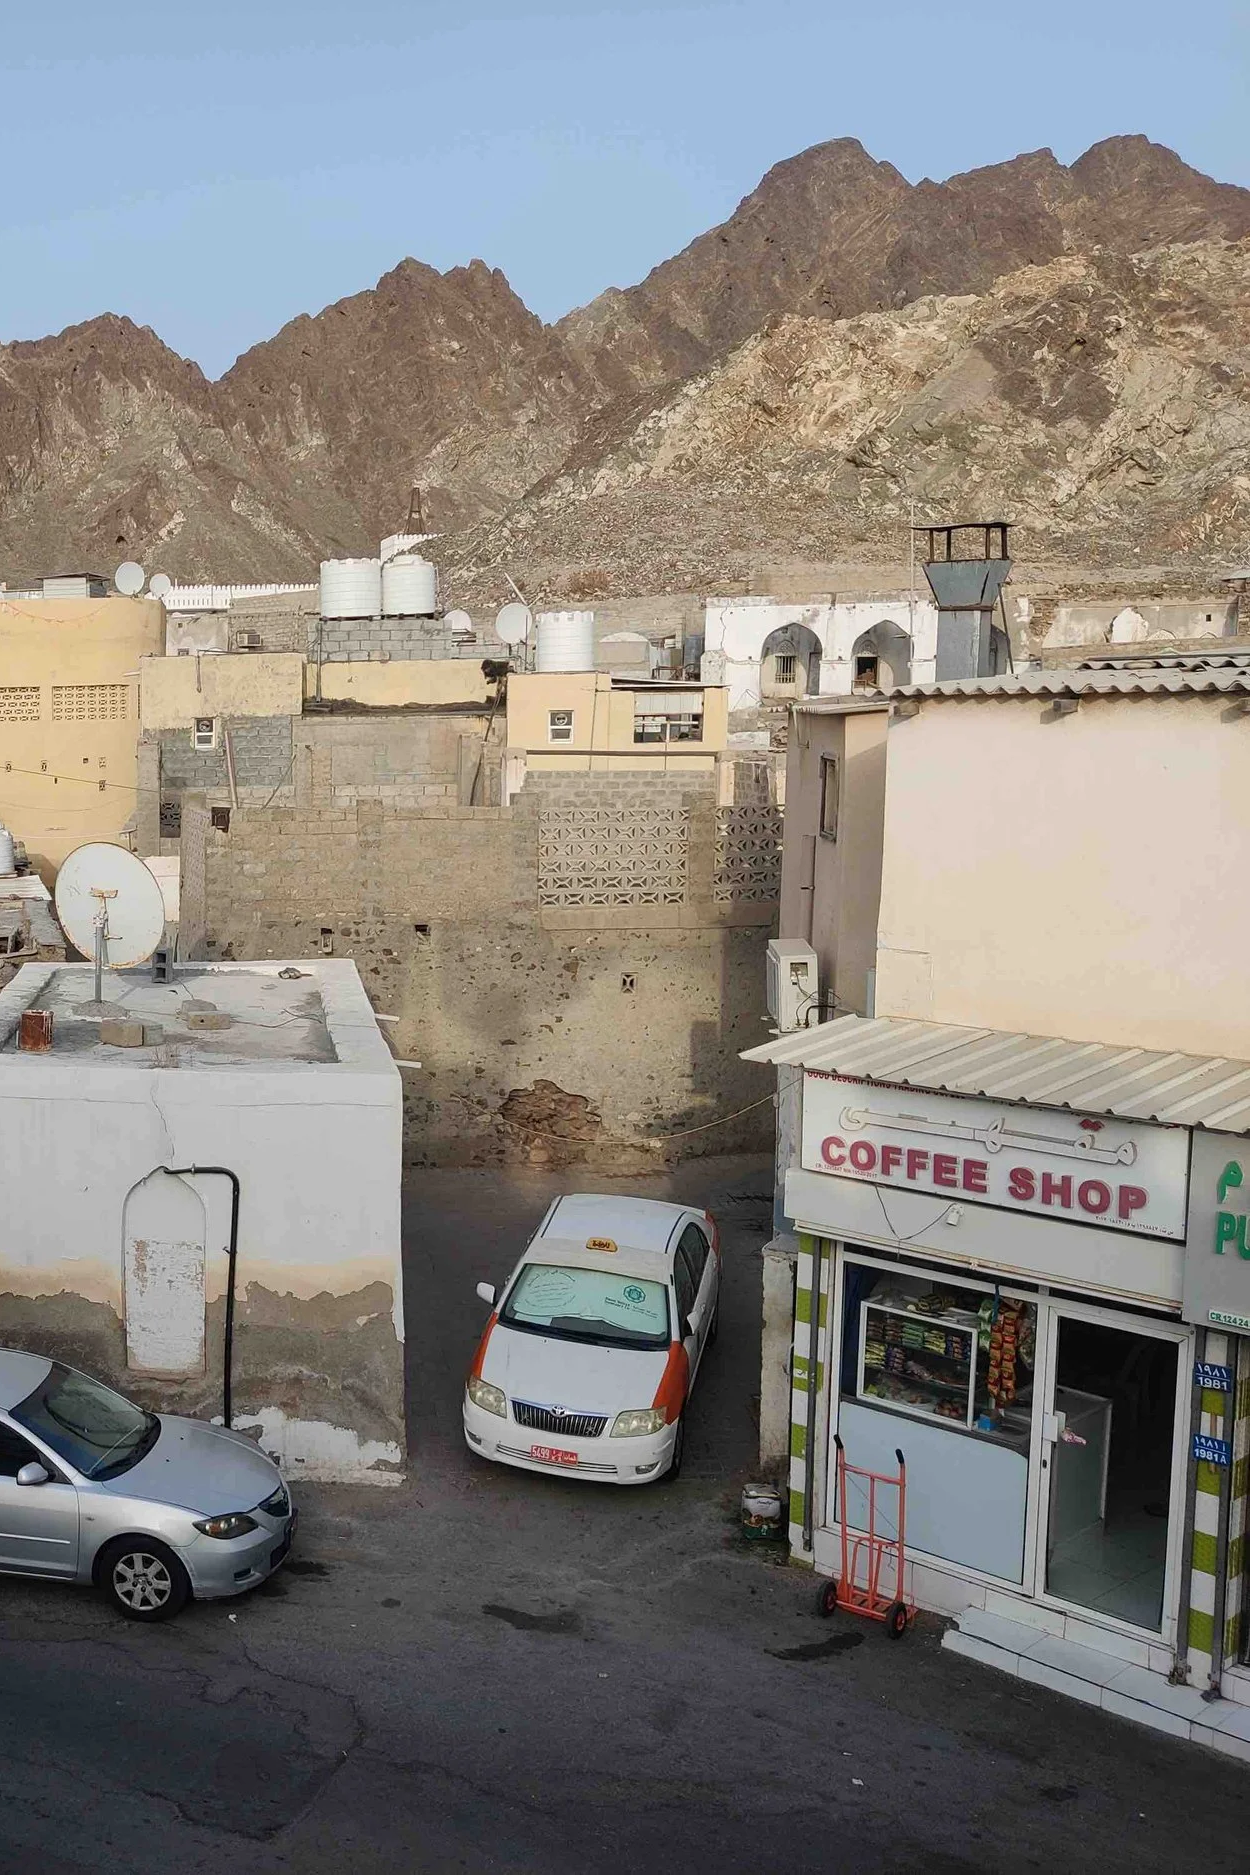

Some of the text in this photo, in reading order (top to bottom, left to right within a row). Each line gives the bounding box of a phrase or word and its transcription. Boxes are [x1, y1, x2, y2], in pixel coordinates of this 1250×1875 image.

[821, 1136, 1150, 1220] COFFEE SHOP
[1198, 1376, 1228, 1391] 1981
